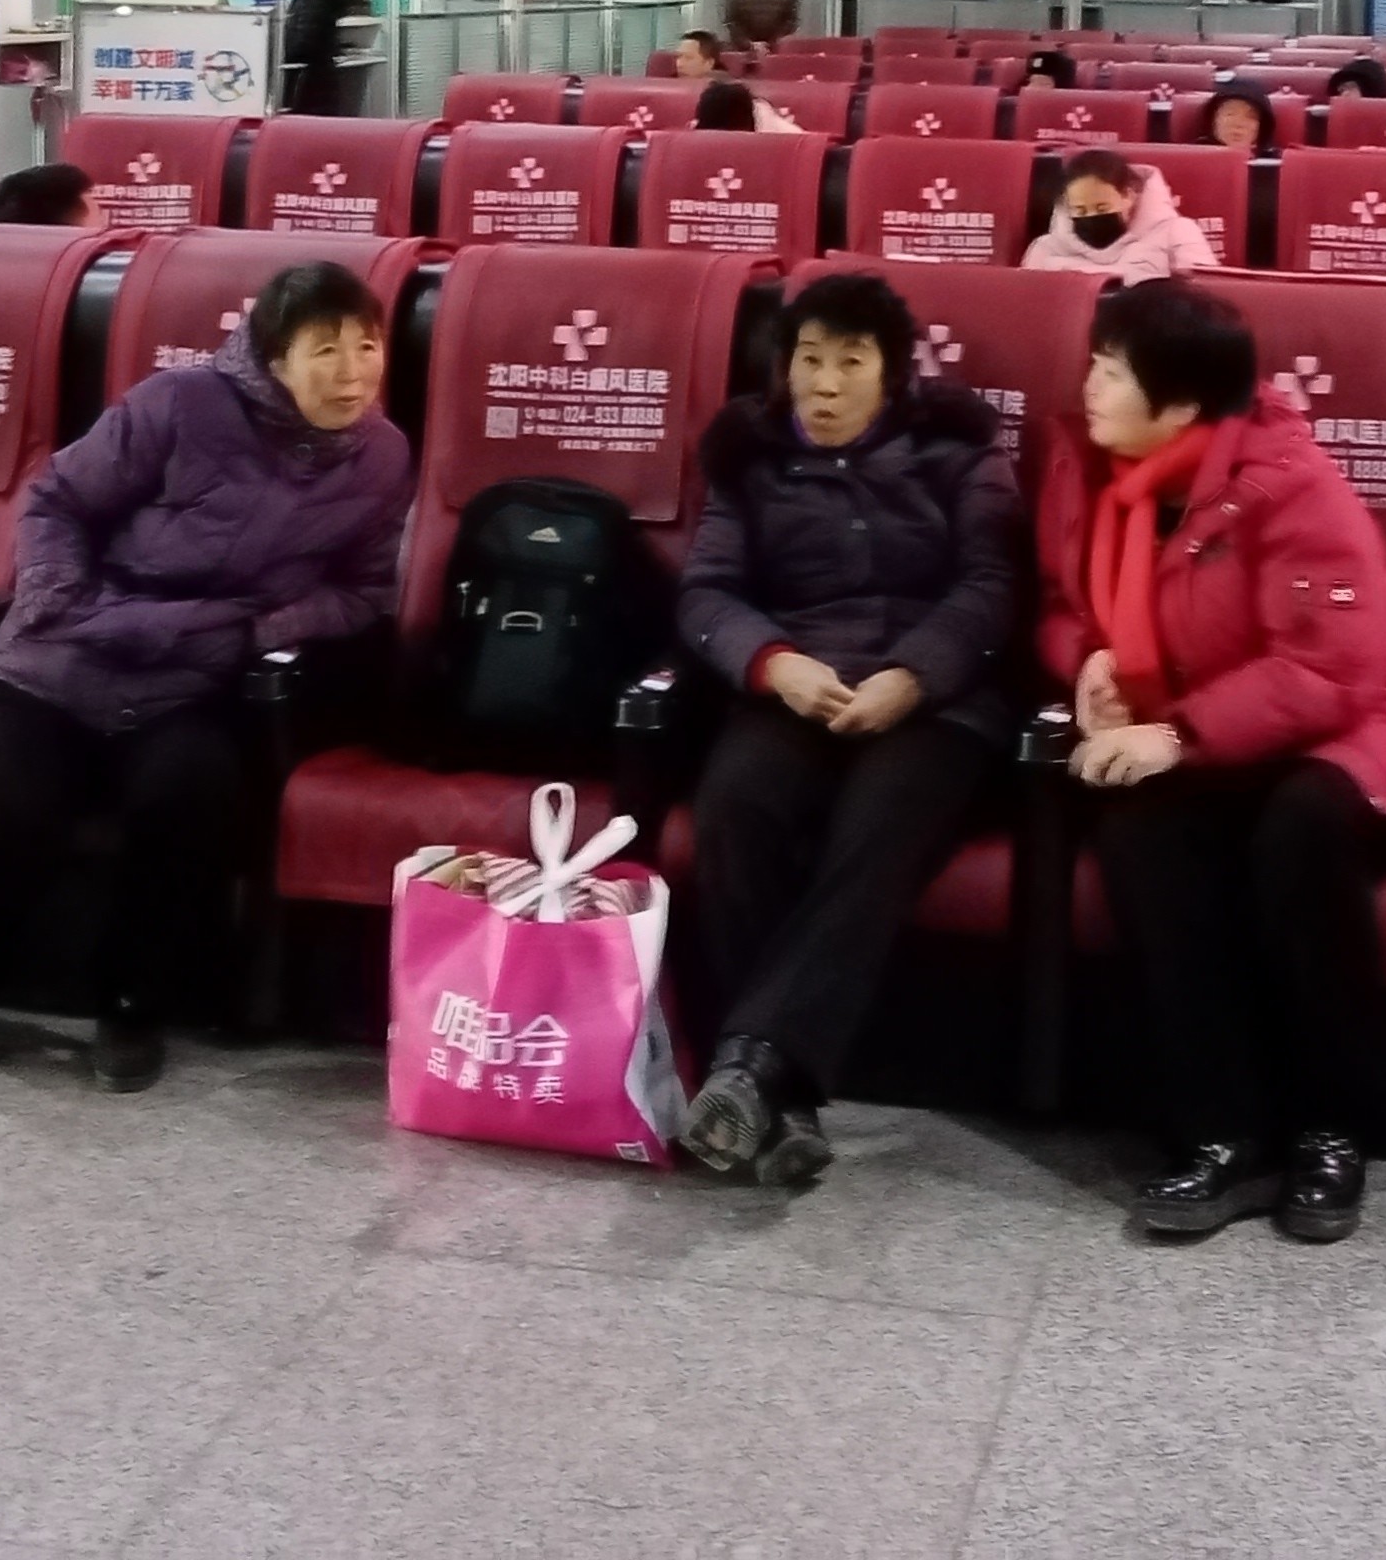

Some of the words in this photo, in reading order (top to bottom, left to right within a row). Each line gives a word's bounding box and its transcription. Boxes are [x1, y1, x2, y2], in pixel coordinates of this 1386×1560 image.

[485, 362, 671, 394] 沈阳中科白癜风医院
[431, 990, 570, 1067] 唯品会
[427, 1046, 565, 1105] 品牌特卖
